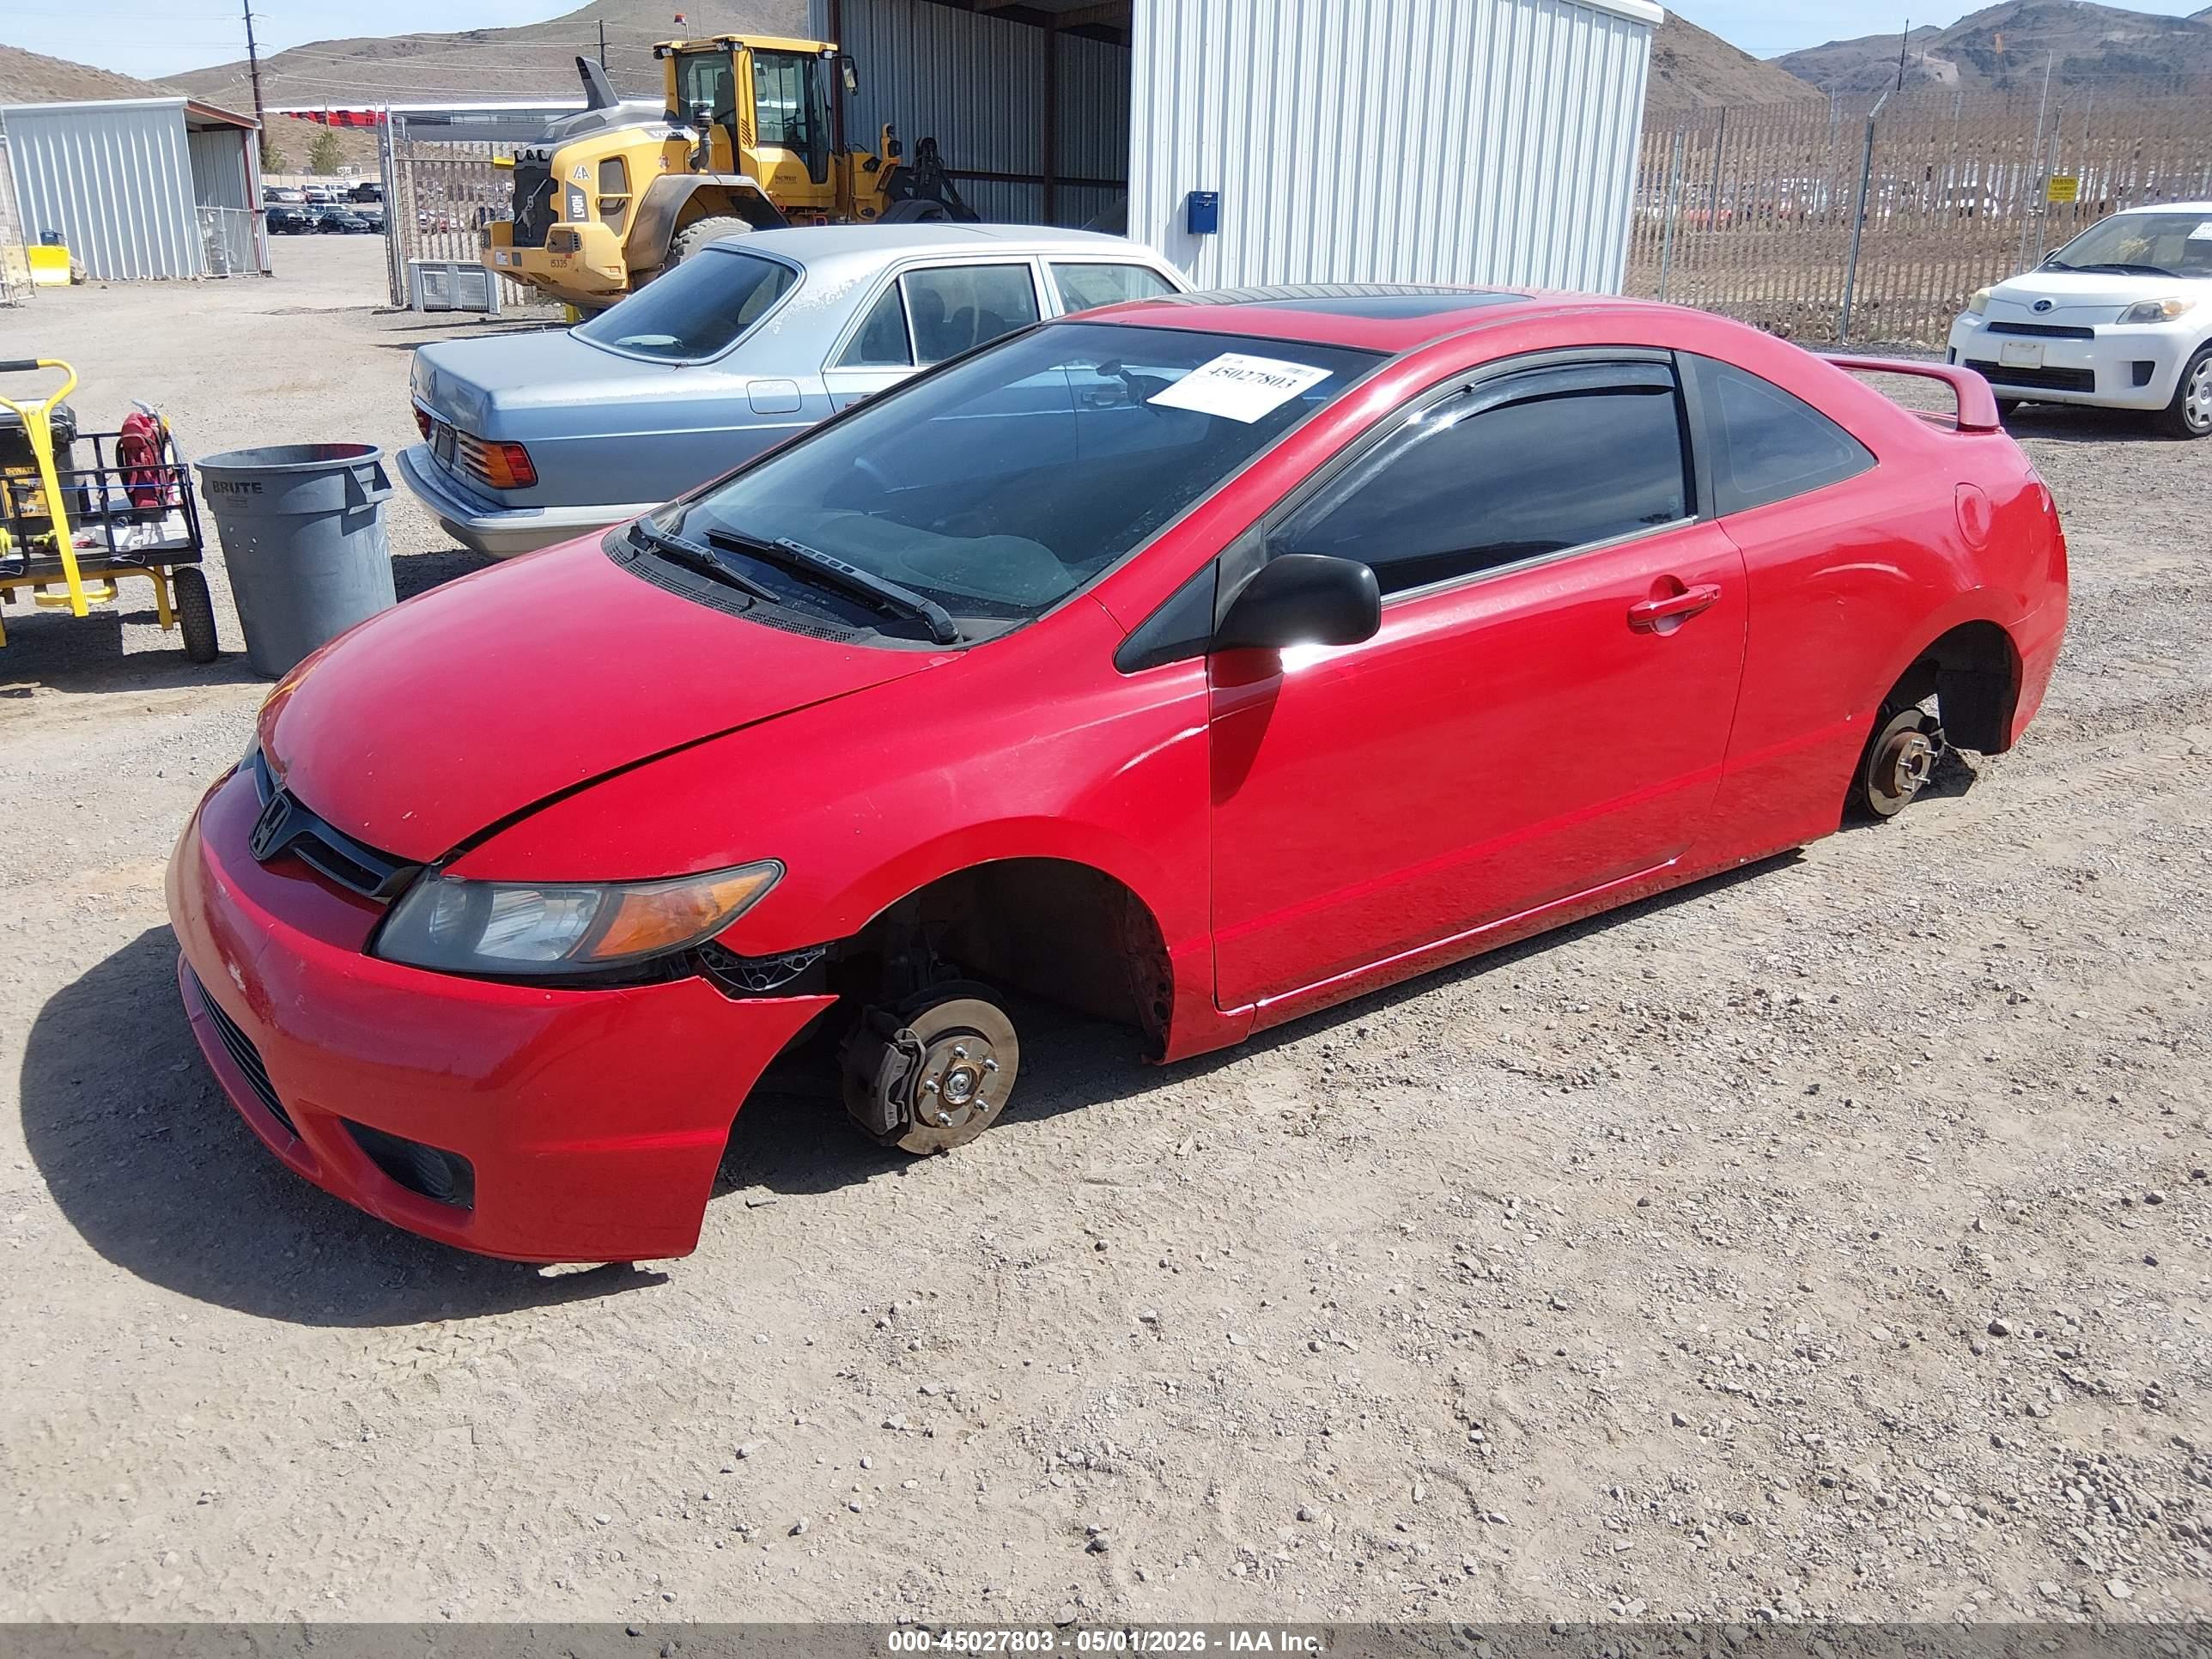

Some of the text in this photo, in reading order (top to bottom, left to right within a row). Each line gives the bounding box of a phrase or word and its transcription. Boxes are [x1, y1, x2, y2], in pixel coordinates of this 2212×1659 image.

[571, 195, 585, 218] L90H
[1209, 367, 1297, 388] 45027803
[212, 481, 263, 494] BRUTE
